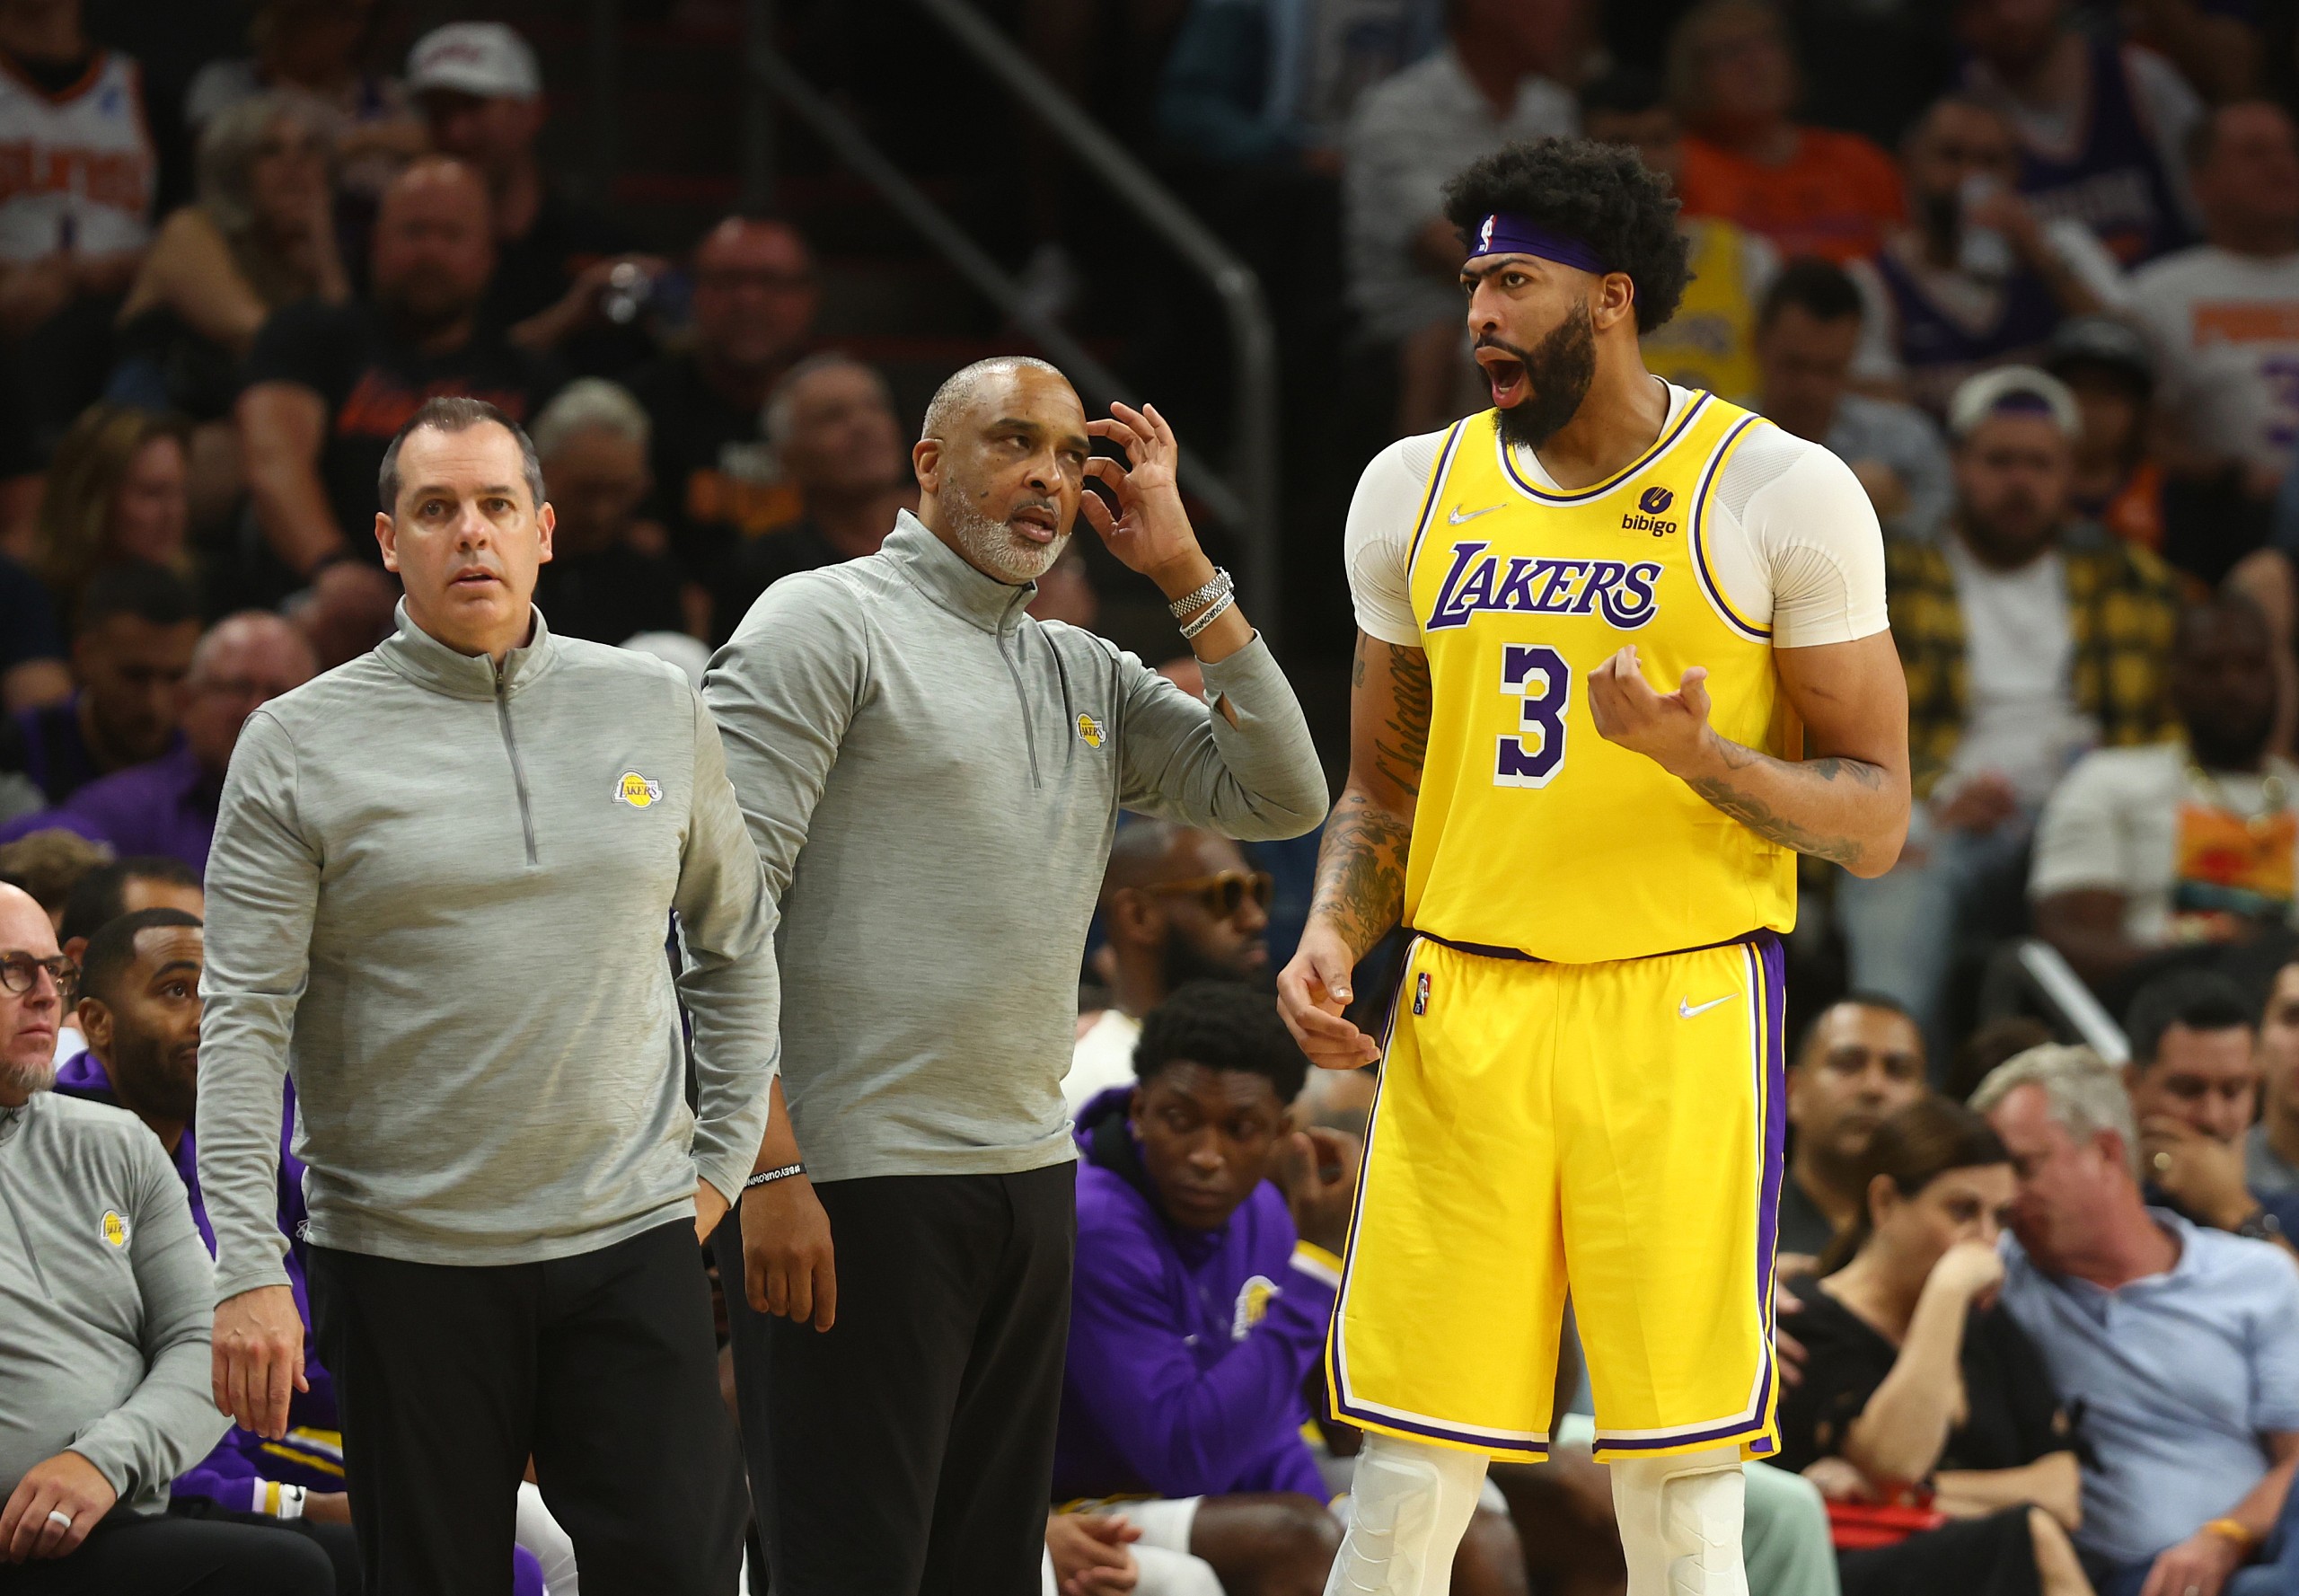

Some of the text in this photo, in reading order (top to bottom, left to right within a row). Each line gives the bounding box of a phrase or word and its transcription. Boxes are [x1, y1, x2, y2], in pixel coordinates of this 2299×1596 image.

[1621, 513, 1678, 537] bibigo
[1425, 540, 1665, 632] LAKERS
[1493, 642, 1572, 789] 3
[617, 780, 661, 800] LAKERS
